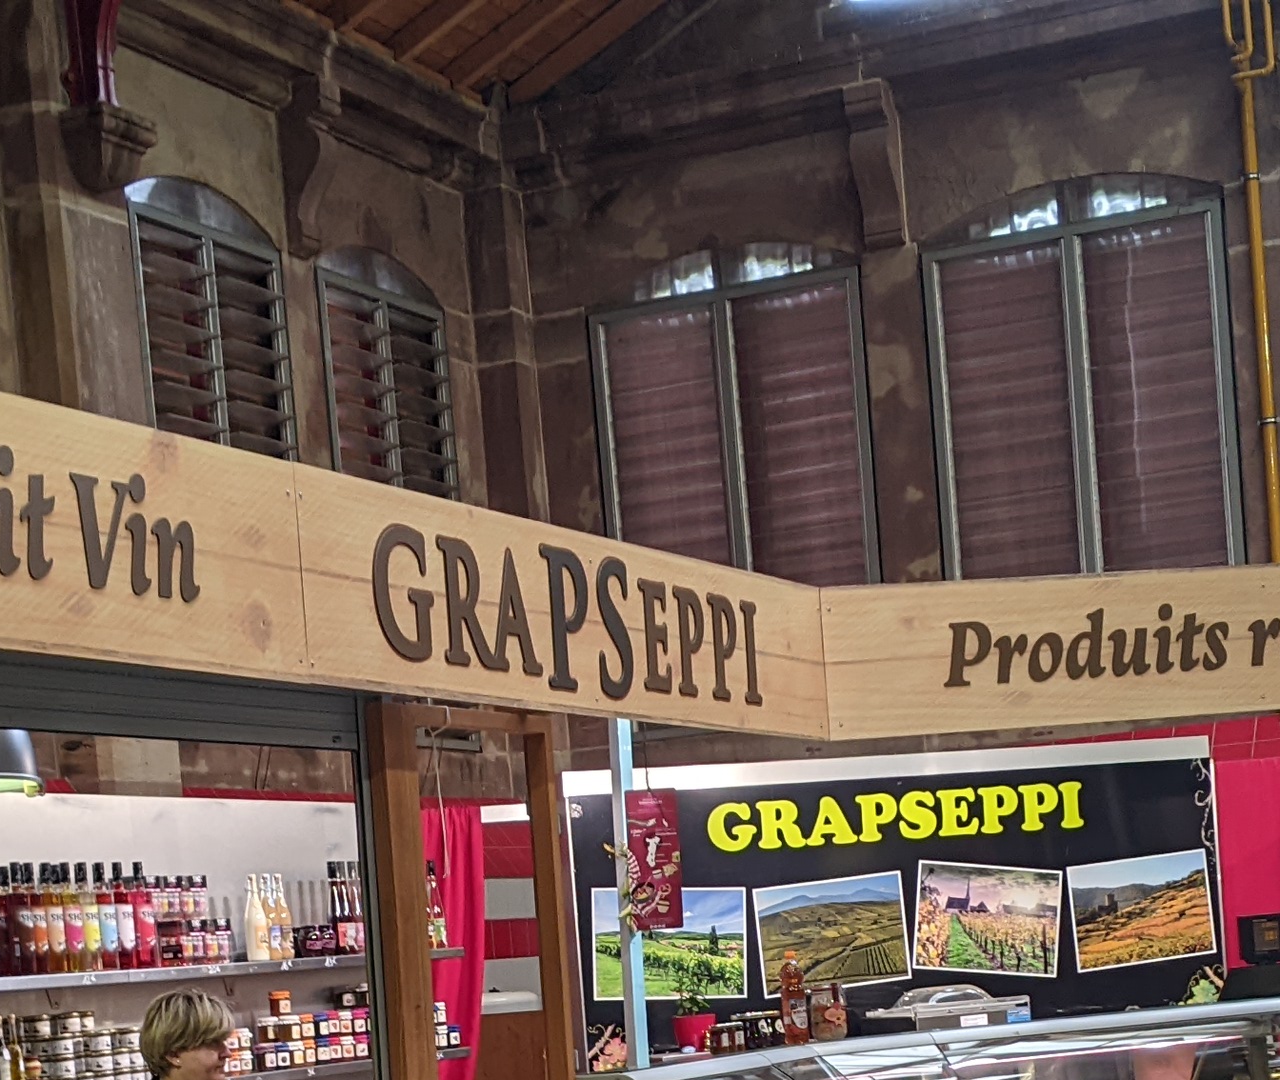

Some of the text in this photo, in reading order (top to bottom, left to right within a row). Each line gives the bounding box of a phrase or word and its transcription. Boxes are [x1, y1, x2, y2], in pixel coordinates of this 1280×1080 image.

[69, 471, 201, 603] Vin
[372, 523, 763, 707] GRAPSEPPI
[943, 603, 1230, 689] Produits
[706, 781, 1085, 852] GRAPSEPPI
